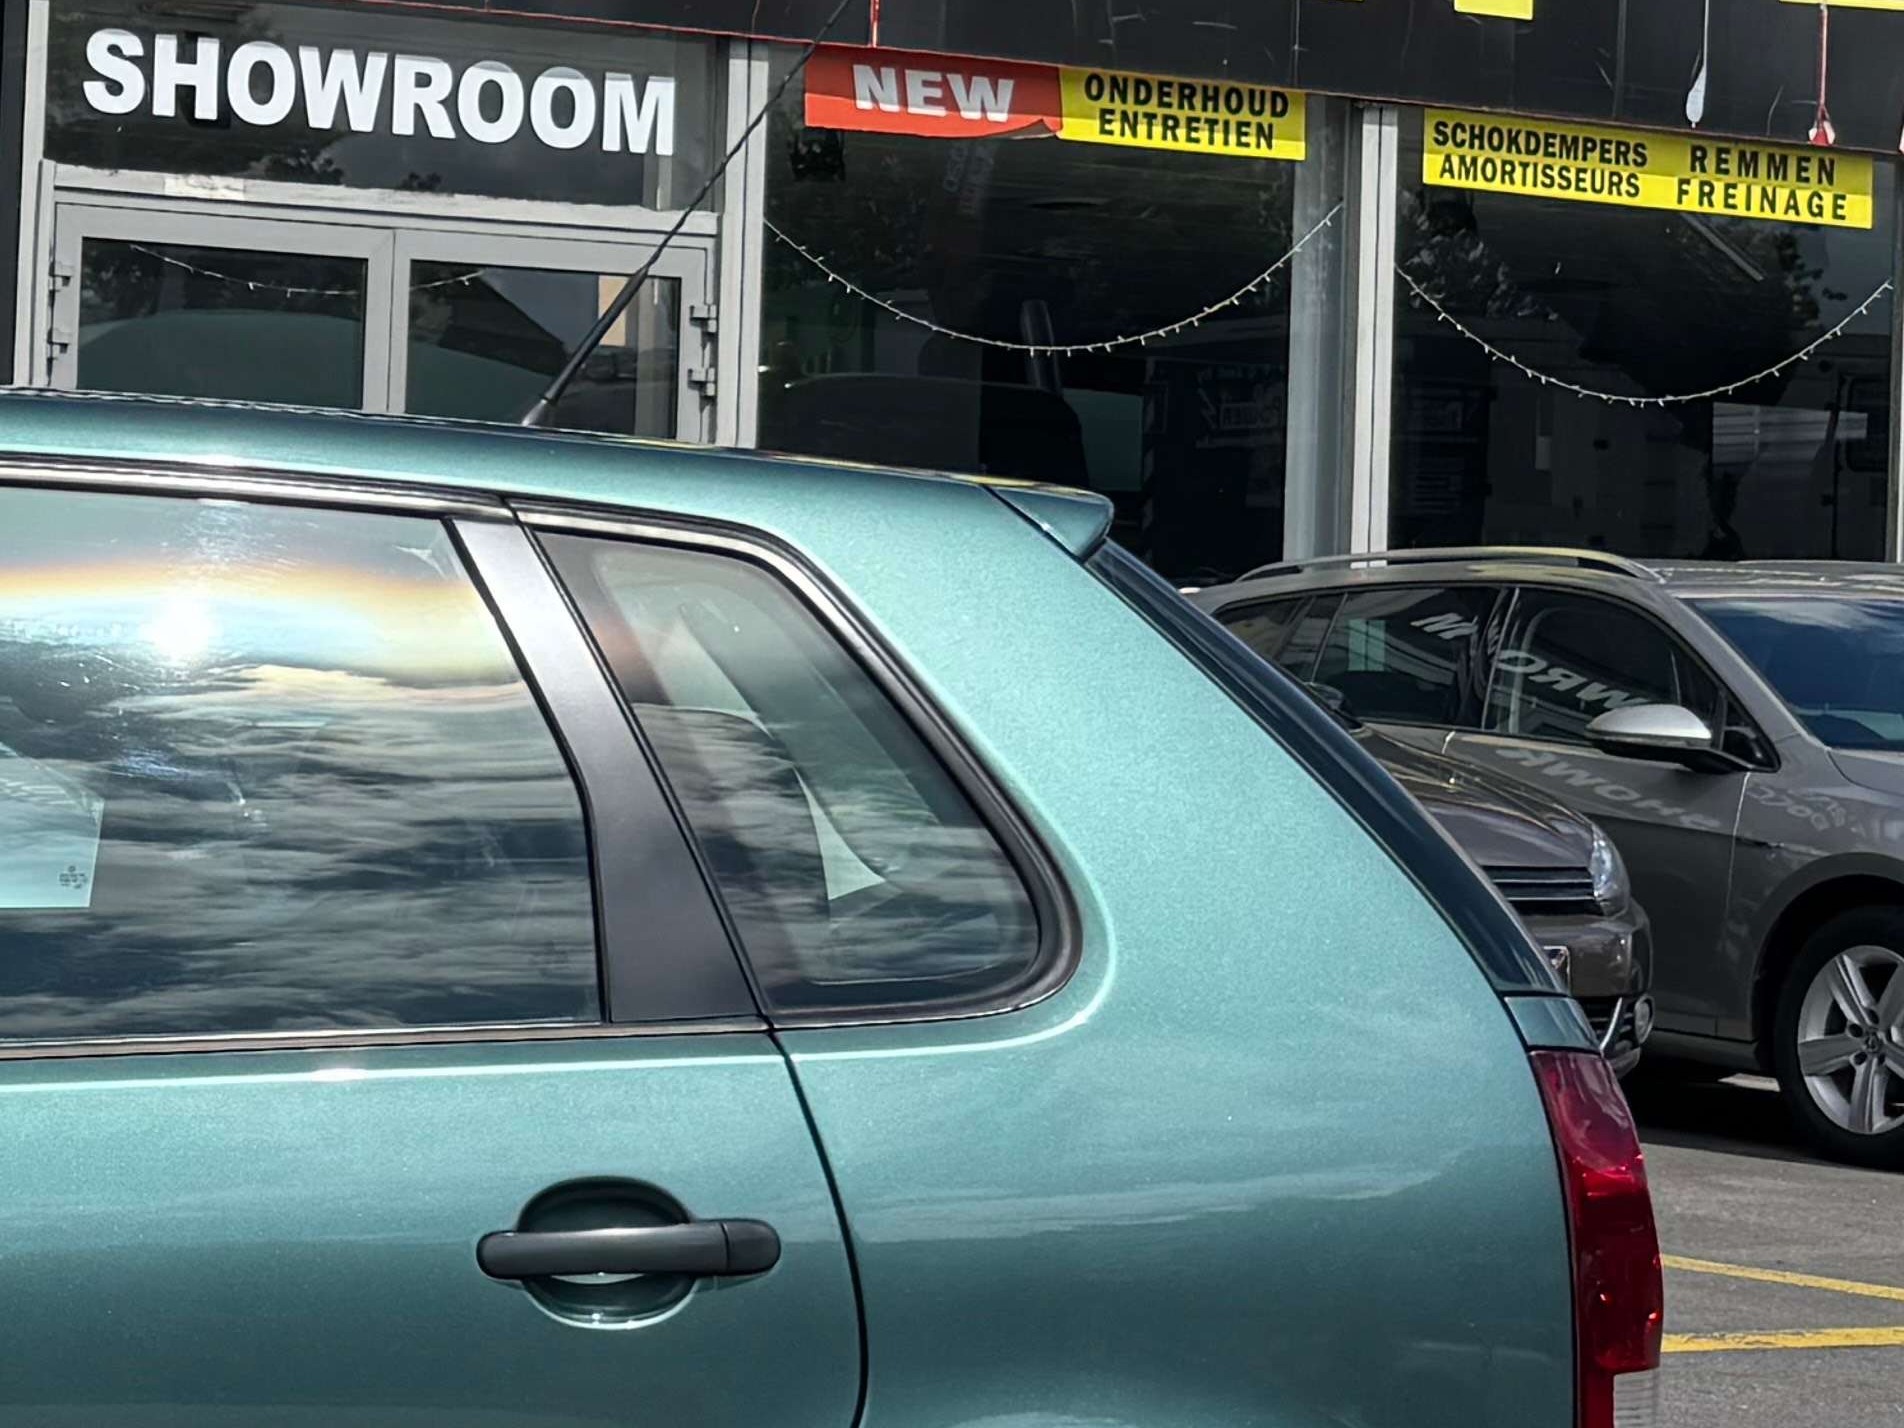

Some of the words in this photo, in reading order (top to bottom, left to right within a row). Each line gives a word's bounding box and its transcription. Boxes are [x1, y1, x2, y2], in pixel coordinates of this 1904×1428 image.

[82, 28, 675, 156] SHOWROOM
[852, 64, 1014, 123] NEW
[1084, 73, 1290, 118] ONDERHOUD
[1099, 109, 1274, 151] ENTRETIEN
[1433, 120, 1648, 168] SCHOKDEMPERS
[1439, 154, 1641, 198] AMORTISSEURS
[1691, 145, 1837, 187] REMMEN
[1677, 178, 1848, 221] FREINAGE
